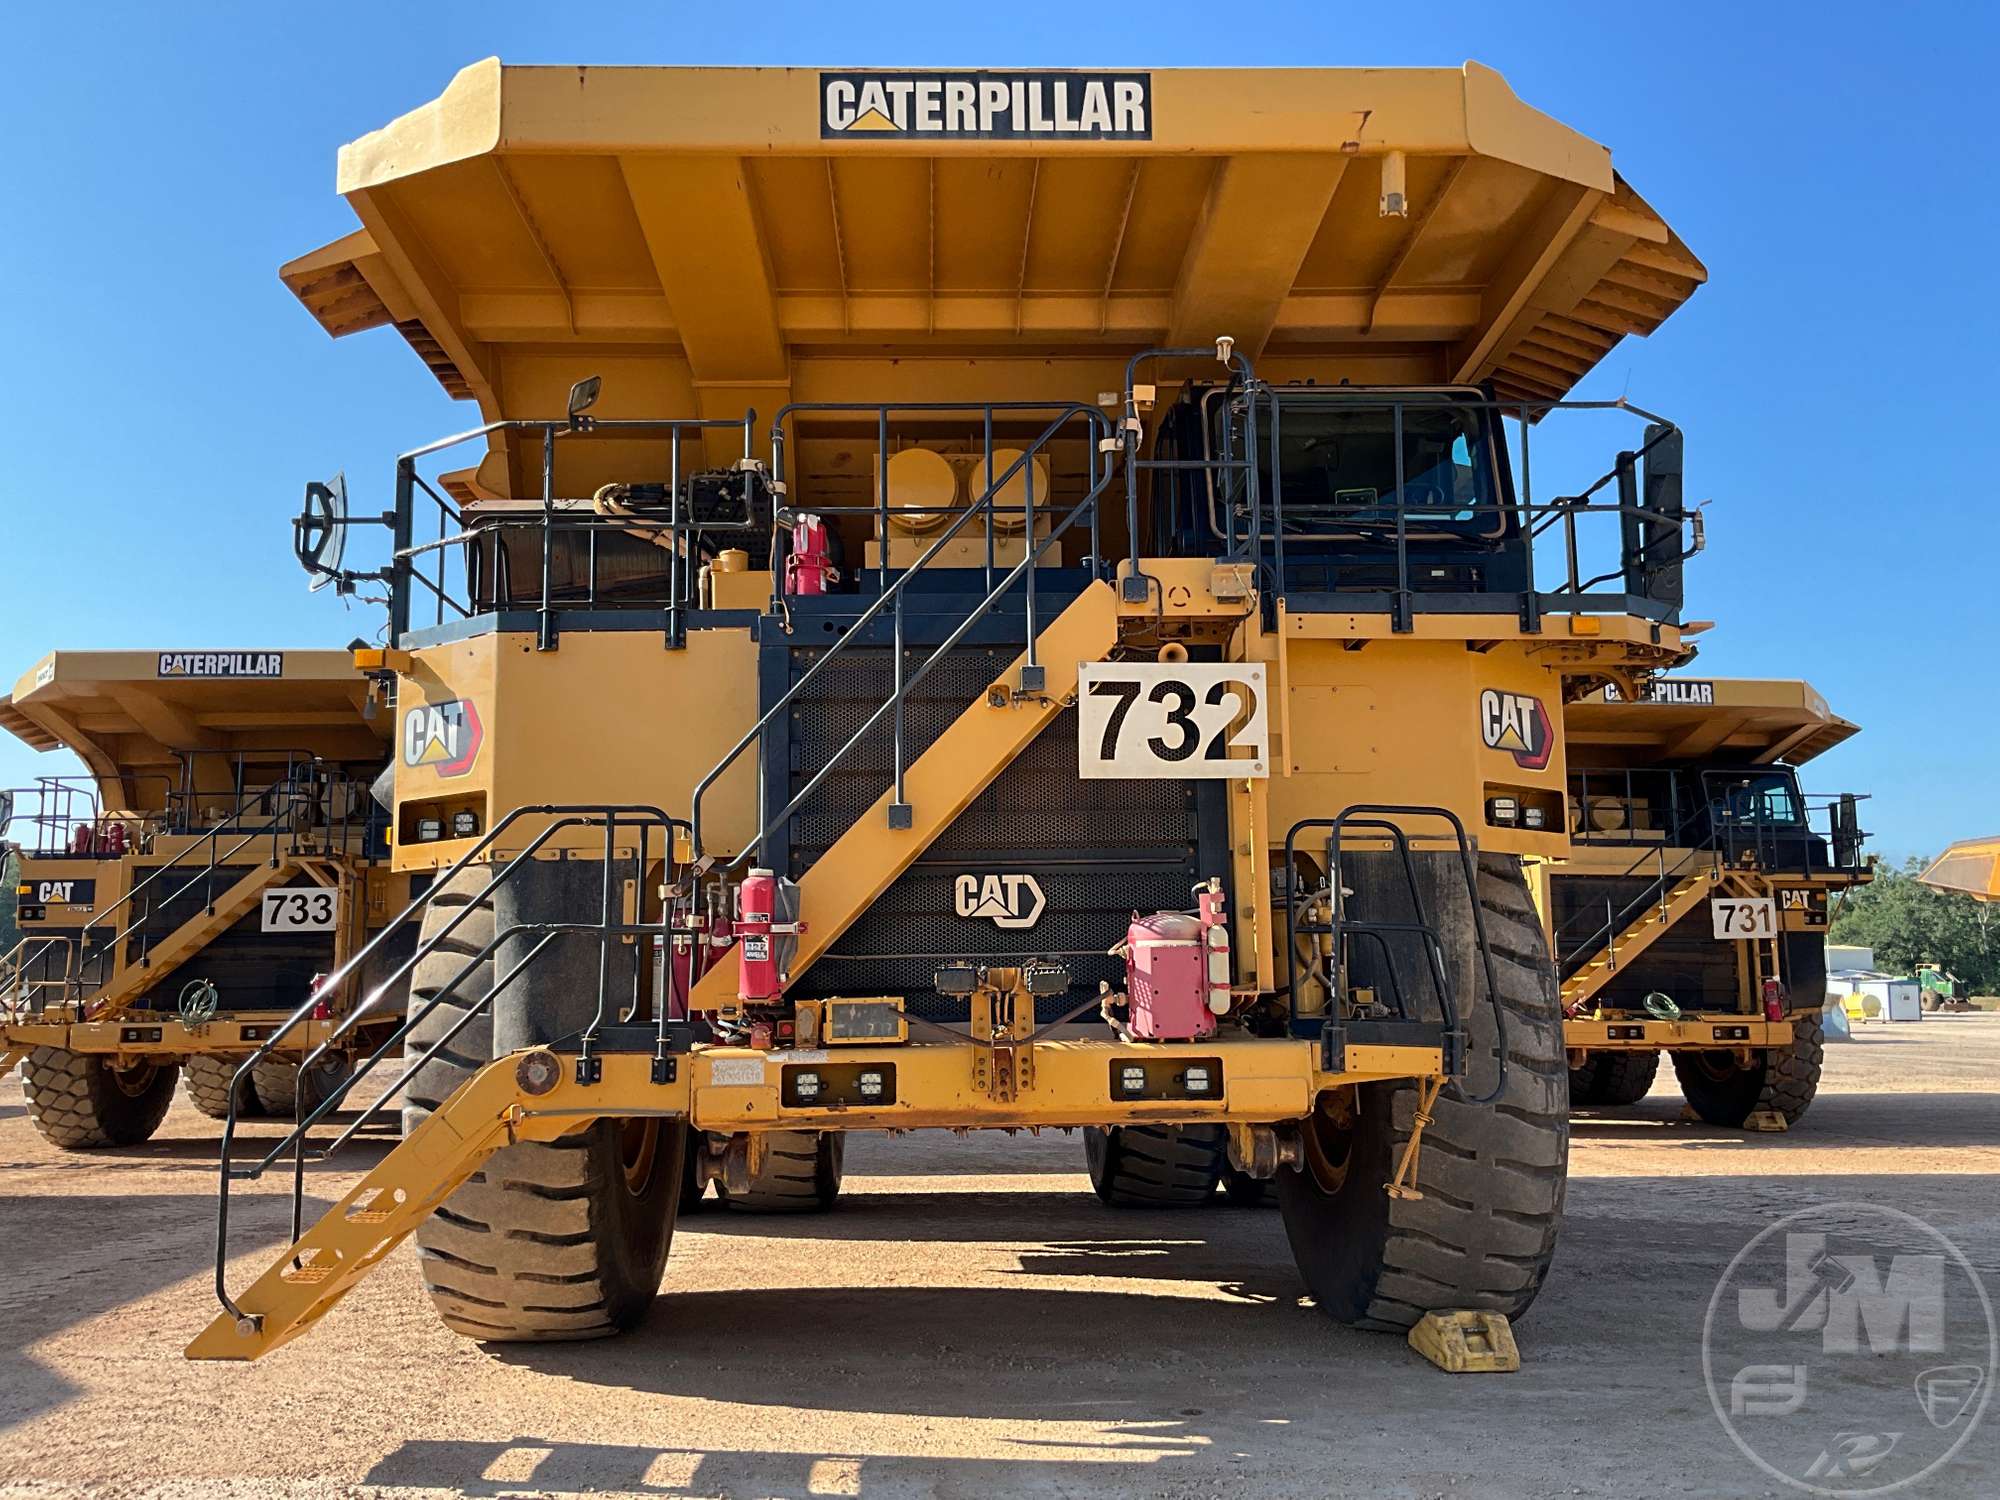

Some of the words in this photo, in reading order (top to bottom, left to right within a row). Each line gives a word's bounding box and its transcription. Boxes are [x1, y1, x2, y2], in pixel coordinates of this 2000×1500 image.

[826, 81, 1145, 131] CATERPILLAR
[160, 654, 281, 675] CATERPILLAR
[1605, 683, 1713, 703] CPILLAR
[405, 701, 464, 765] CAT
[1089, 680, 1259, 762] 732
[1481, 690, 1535, 752] CAT
[39, 882, 74, 903] CAT
[955, 874, 1019, 917] CAT
[1781, 890, 1810, 909] CAT
[267, 894, 332, 925] 733
[1718, 904, 1771, 932] 731
